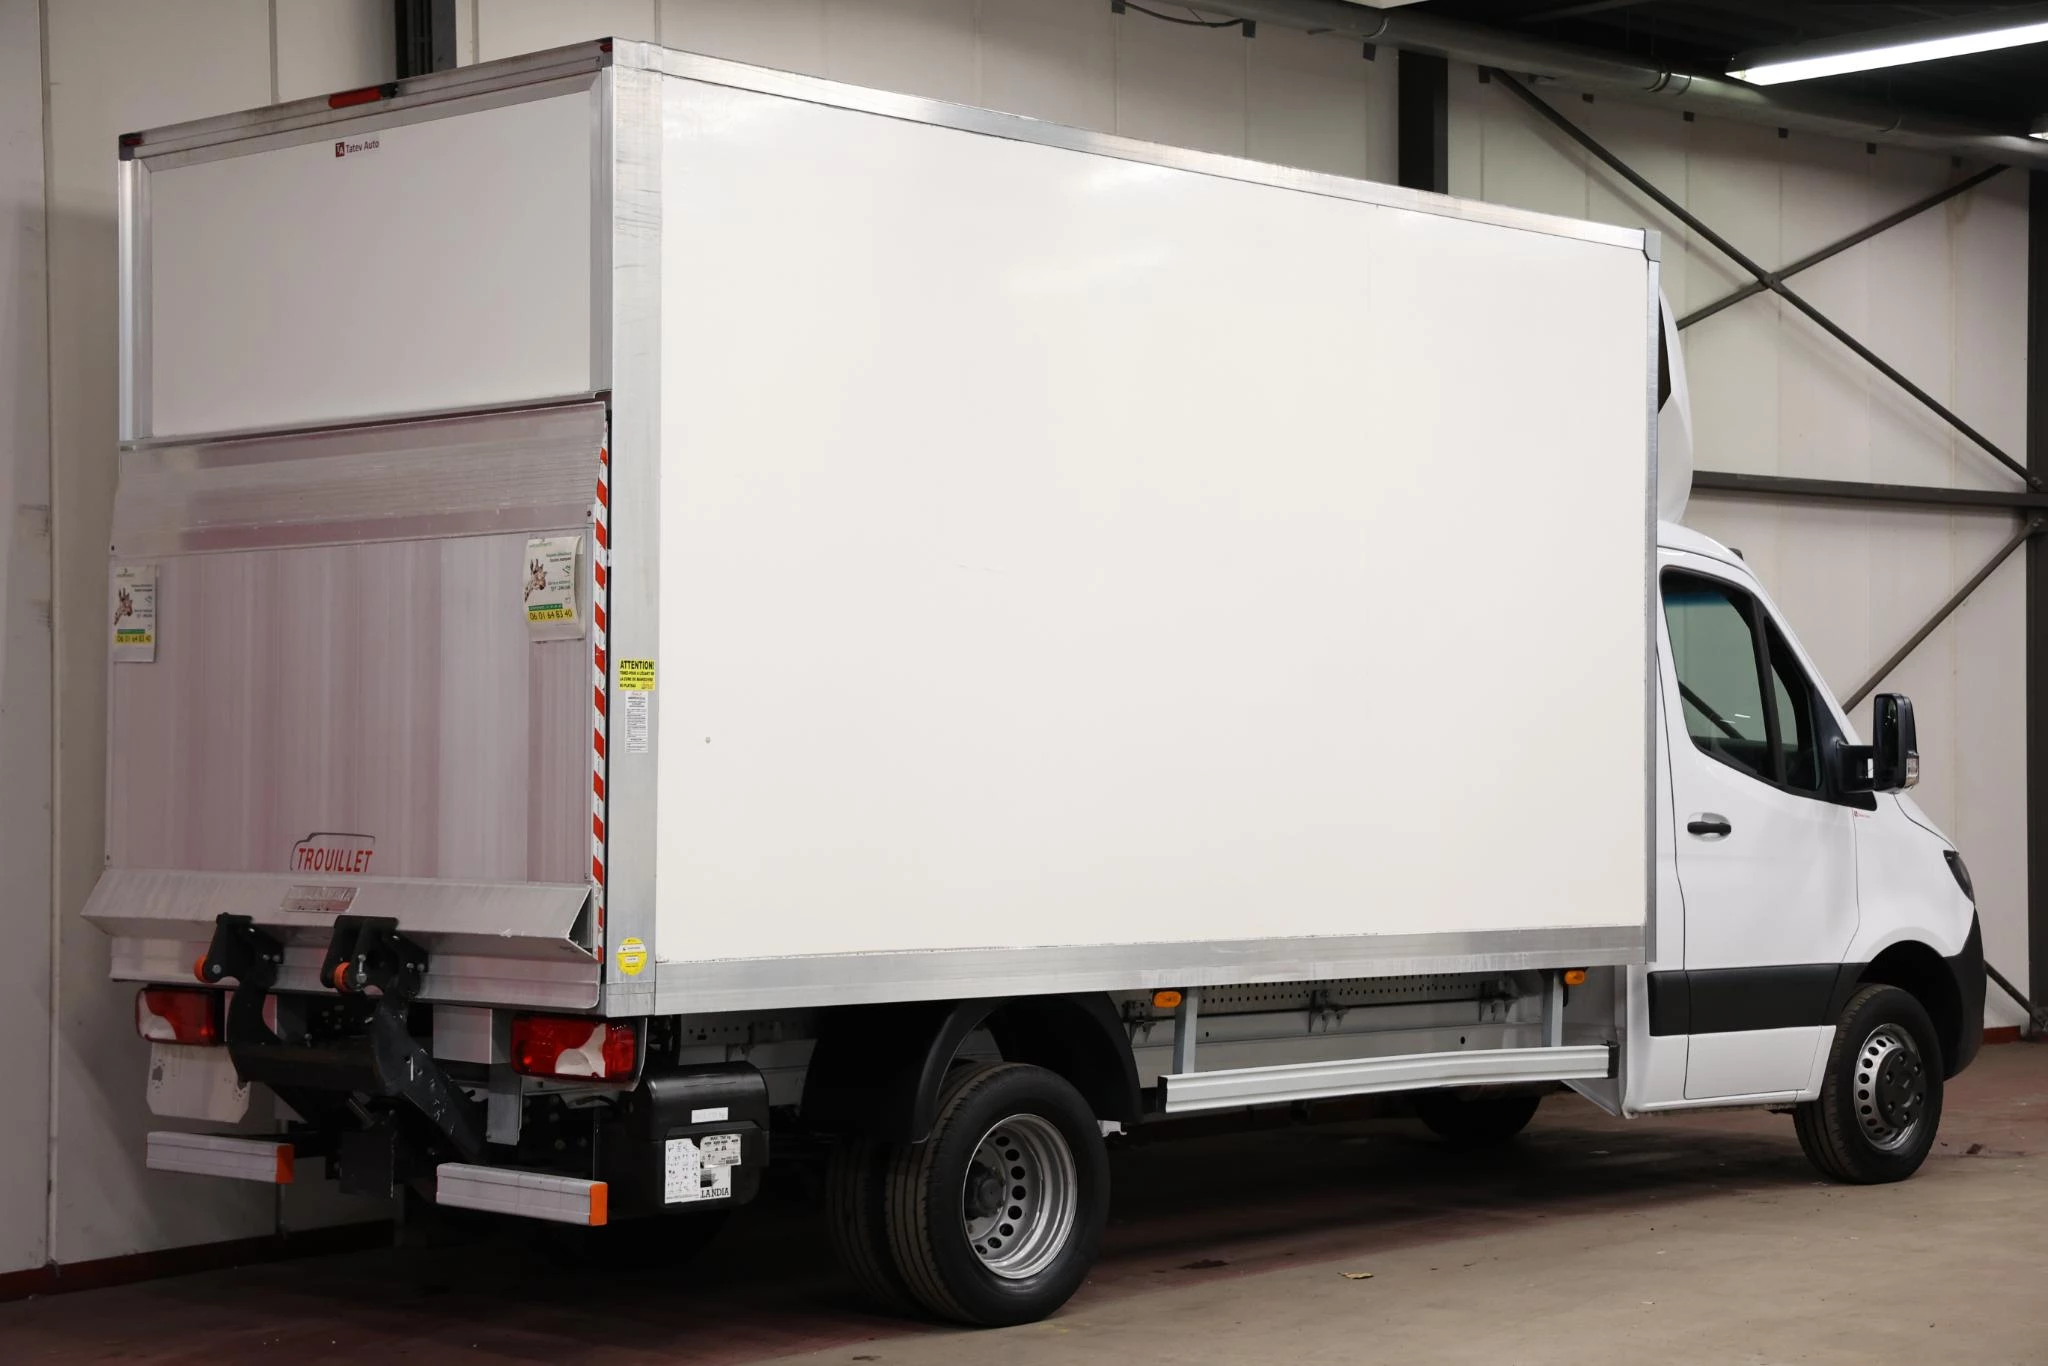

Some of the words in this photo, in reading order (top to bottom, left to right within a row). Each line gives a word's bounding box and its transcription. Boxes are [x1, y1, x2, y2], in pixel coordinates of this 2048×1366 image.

[346, 144, 362, 153] Tatev
[364, 140, 380, 150] Auto
[620, 660, 655, 670] ATTENTION!
[298, 848, 373, 873] TROUILLET
[702, 1187, 730, 1198] LANDIA
